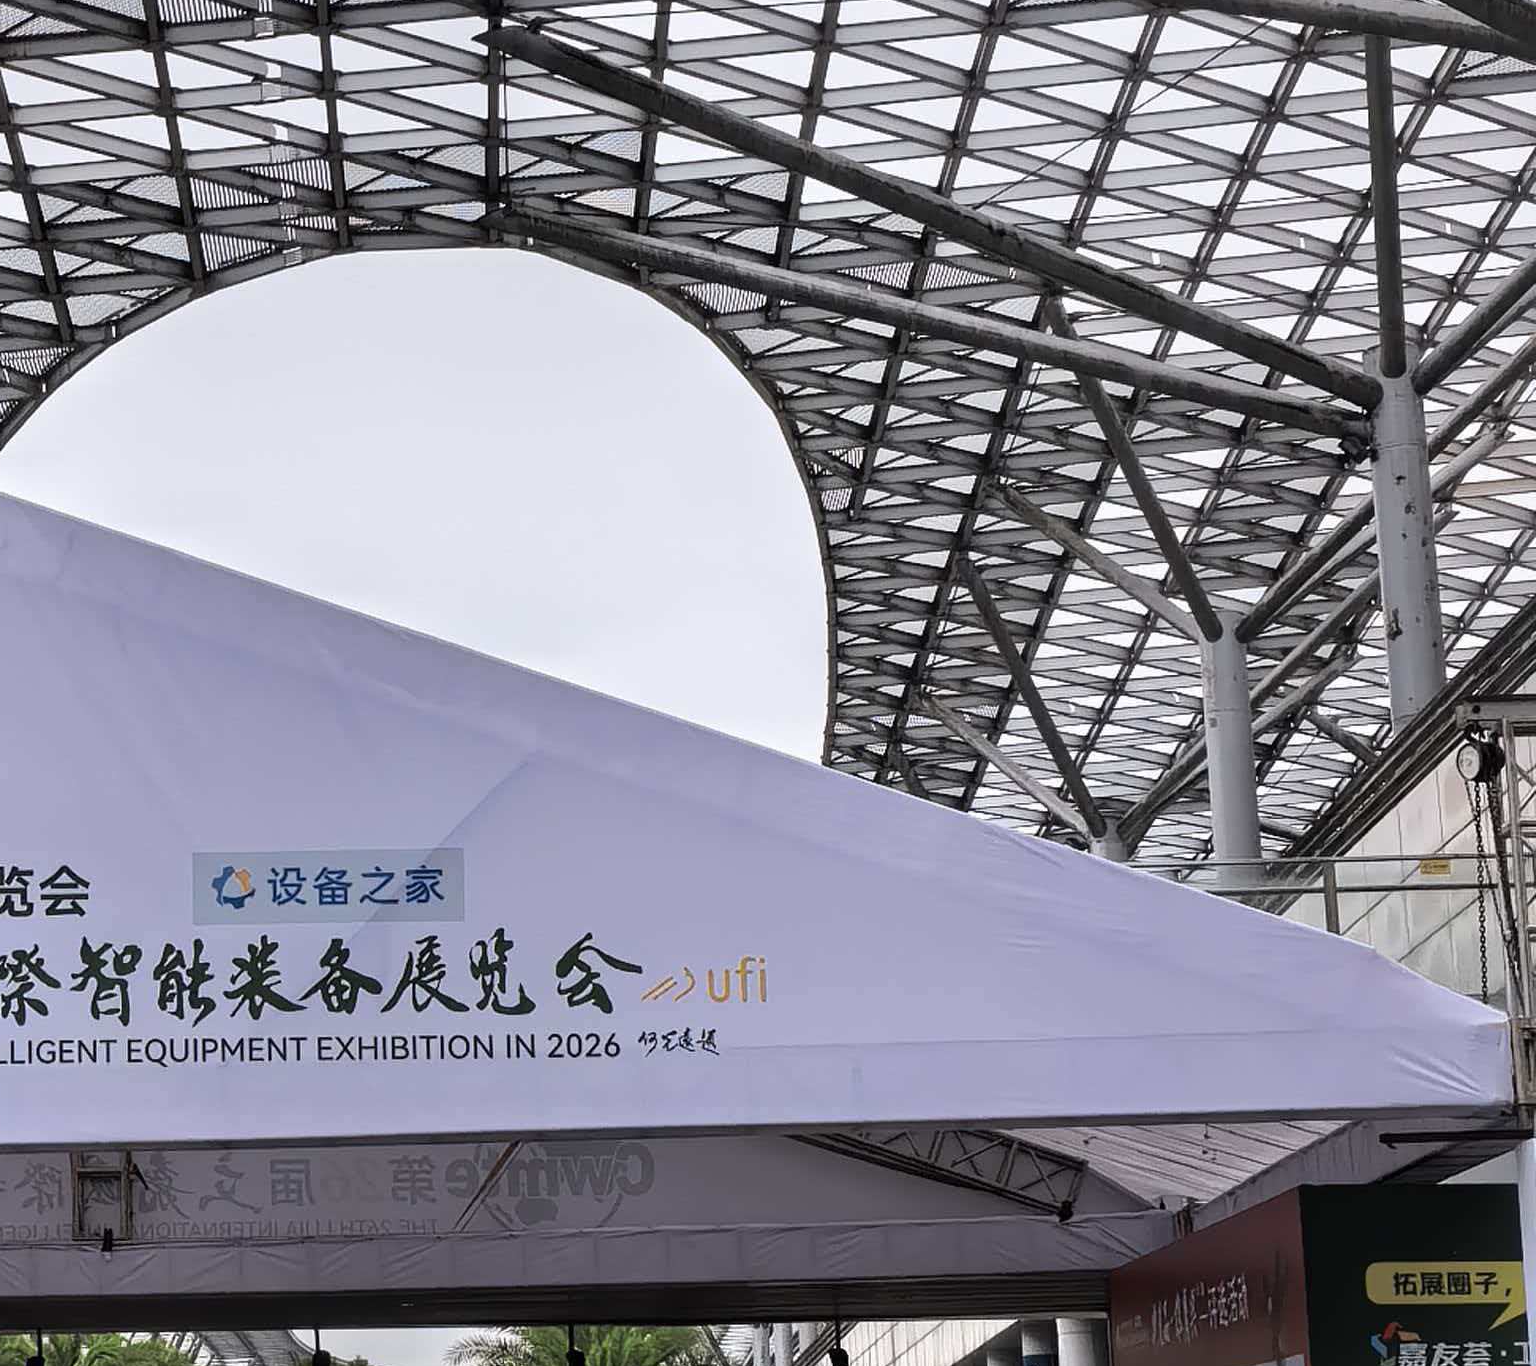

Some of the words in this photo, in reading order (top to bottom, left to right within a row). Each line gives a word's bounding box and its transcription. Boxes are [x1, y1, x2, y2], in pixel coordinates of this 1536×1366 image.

[267, 865, 445, 906] 设备之家
[707, 954, 767, 1003] ufi
[127, 1037, 308, 1067] EQUIPMENT
[317, 1033, 493, 1061] EXHIBITION
[507, 1033, 536, 1058] IN
[548, 1032, 621, 1059] 2026
